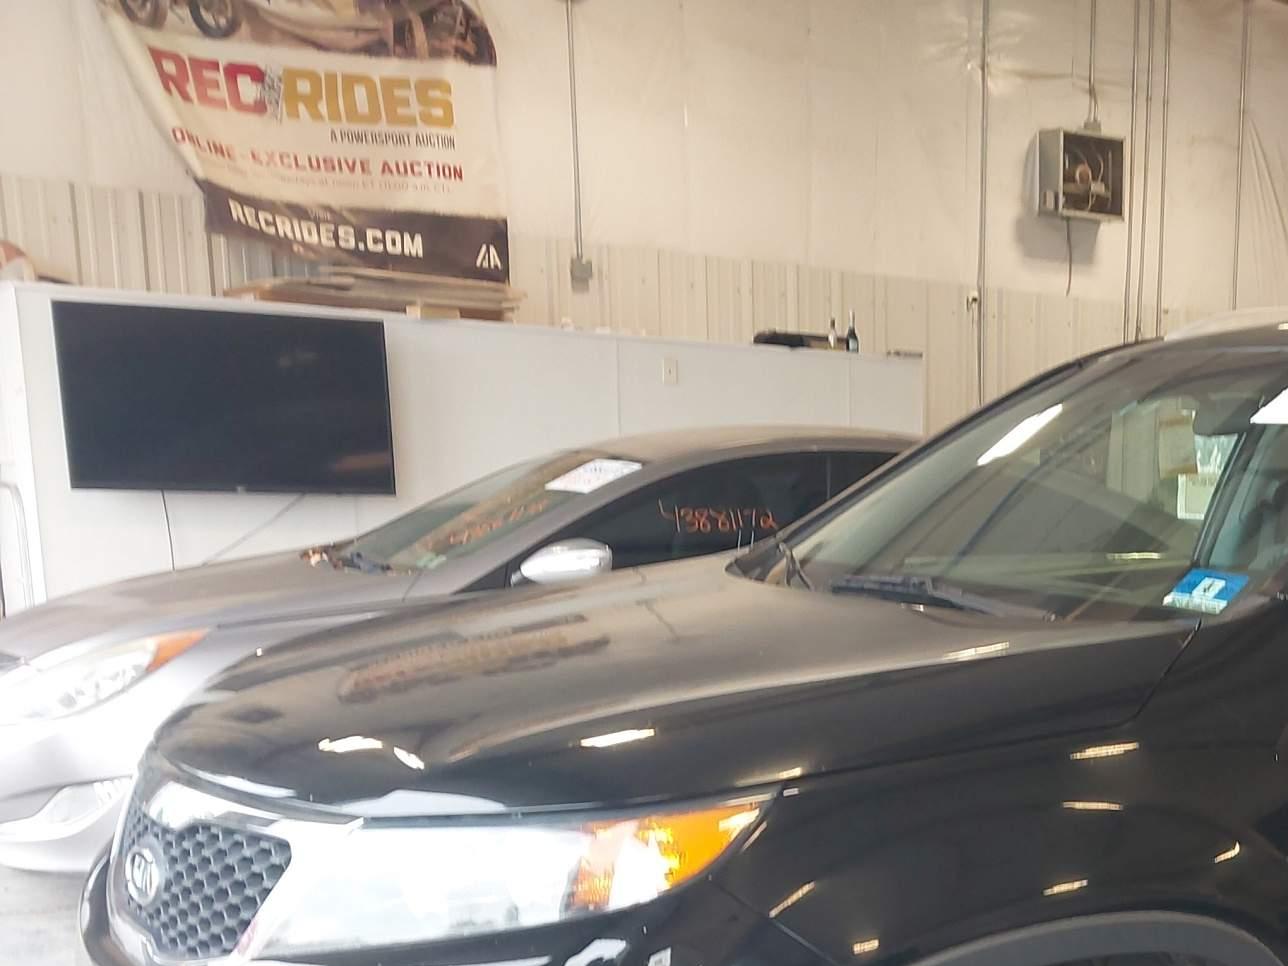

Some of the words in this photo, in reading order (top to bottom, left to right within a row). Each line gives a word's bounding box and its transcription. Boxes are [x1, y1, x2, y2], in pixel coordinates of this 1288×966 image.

[147, 46, 267, 115] REC
[282, 67, 455, 129] RIDES
[172, 127, 235, 160] ONLINE
[250, 149, 372, 176] EXCLUSIVE
[381, 158, 463, 181] AUCTION
[330, 128, 338, 144] A
[340, 130, 411, 147] POWERSPORT
[415, 132, 456, 150] AUCTION
[229, 198, 424, 259] RECRIDES.COM
